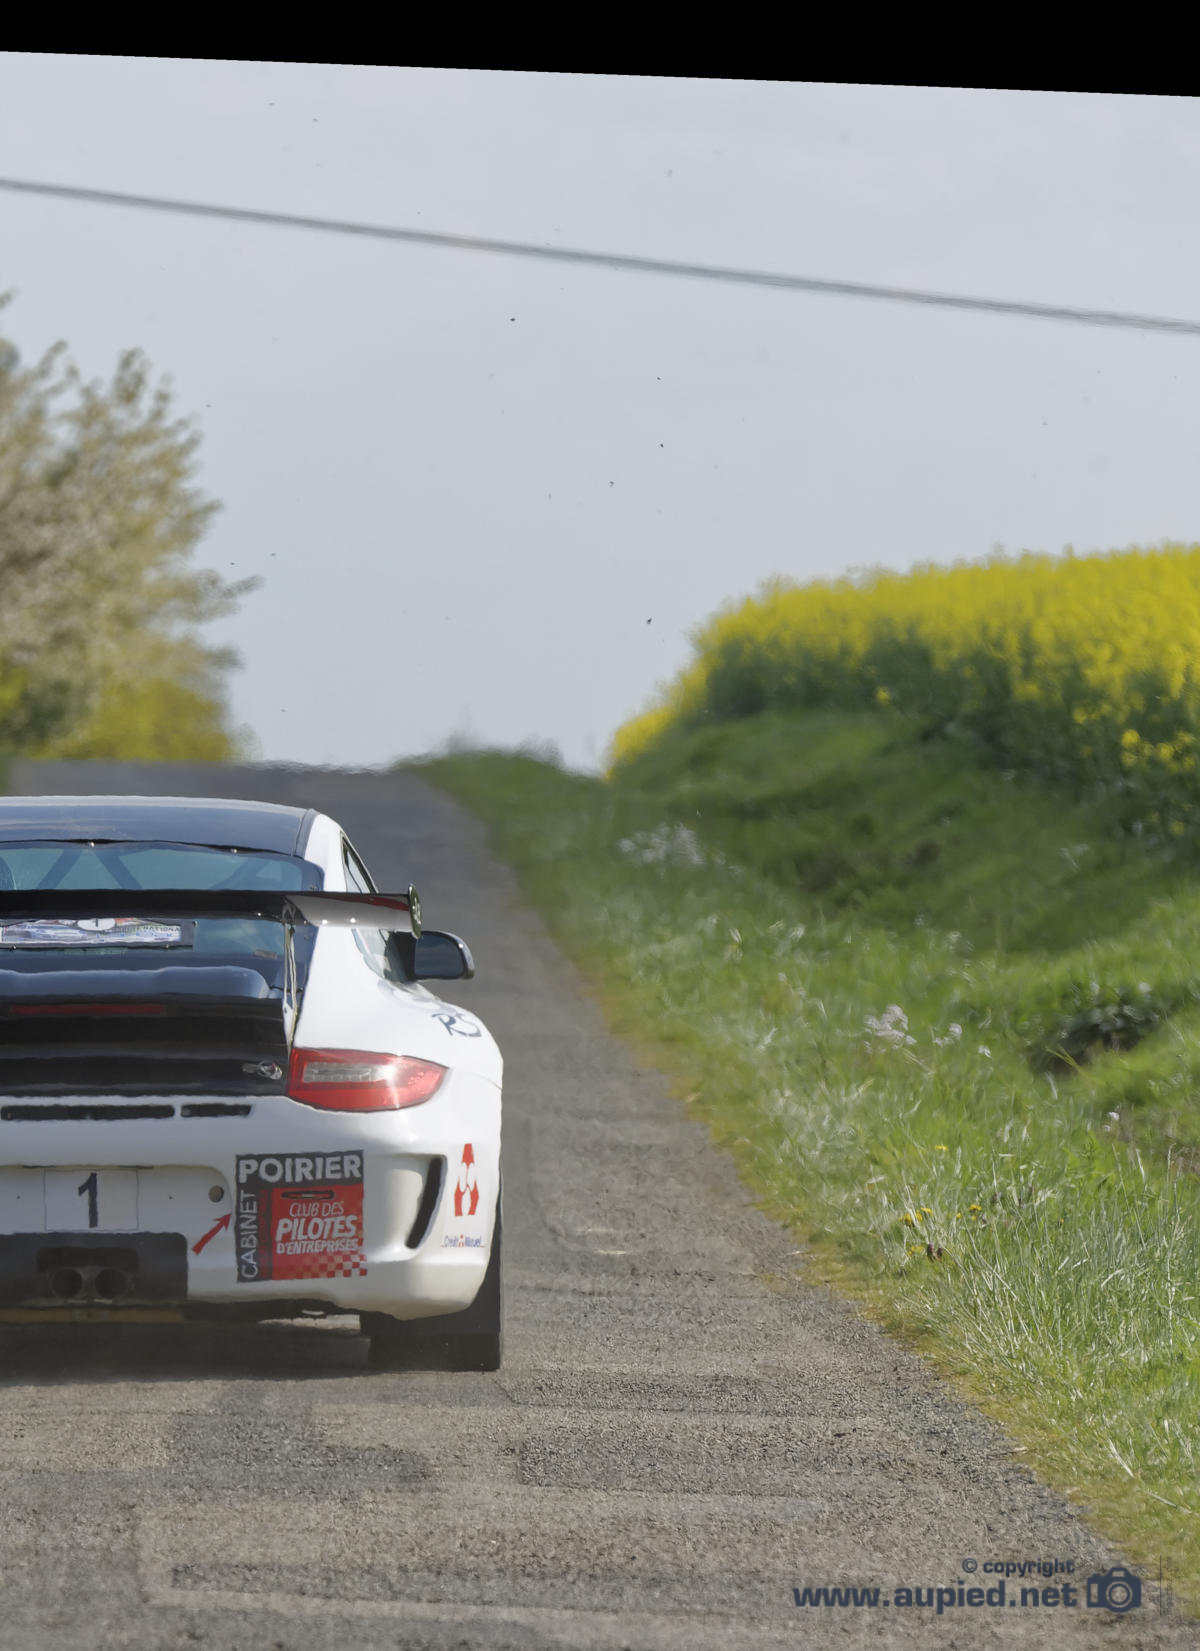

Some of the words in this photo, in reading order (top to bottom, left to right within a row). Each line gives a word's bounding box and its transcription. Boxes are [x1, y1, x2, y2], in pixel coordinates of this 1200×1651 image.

[239, 1155, 361, 1183] POIRIER
[78, 1172, 99, 1228] 1
[289, 1202, 319, 1217] CLUB
[321, 1201, 344, 1216] DES
[240, 1190, 259, 1278] CABINET
[275, 1214, 358, 1241] PILOTES
